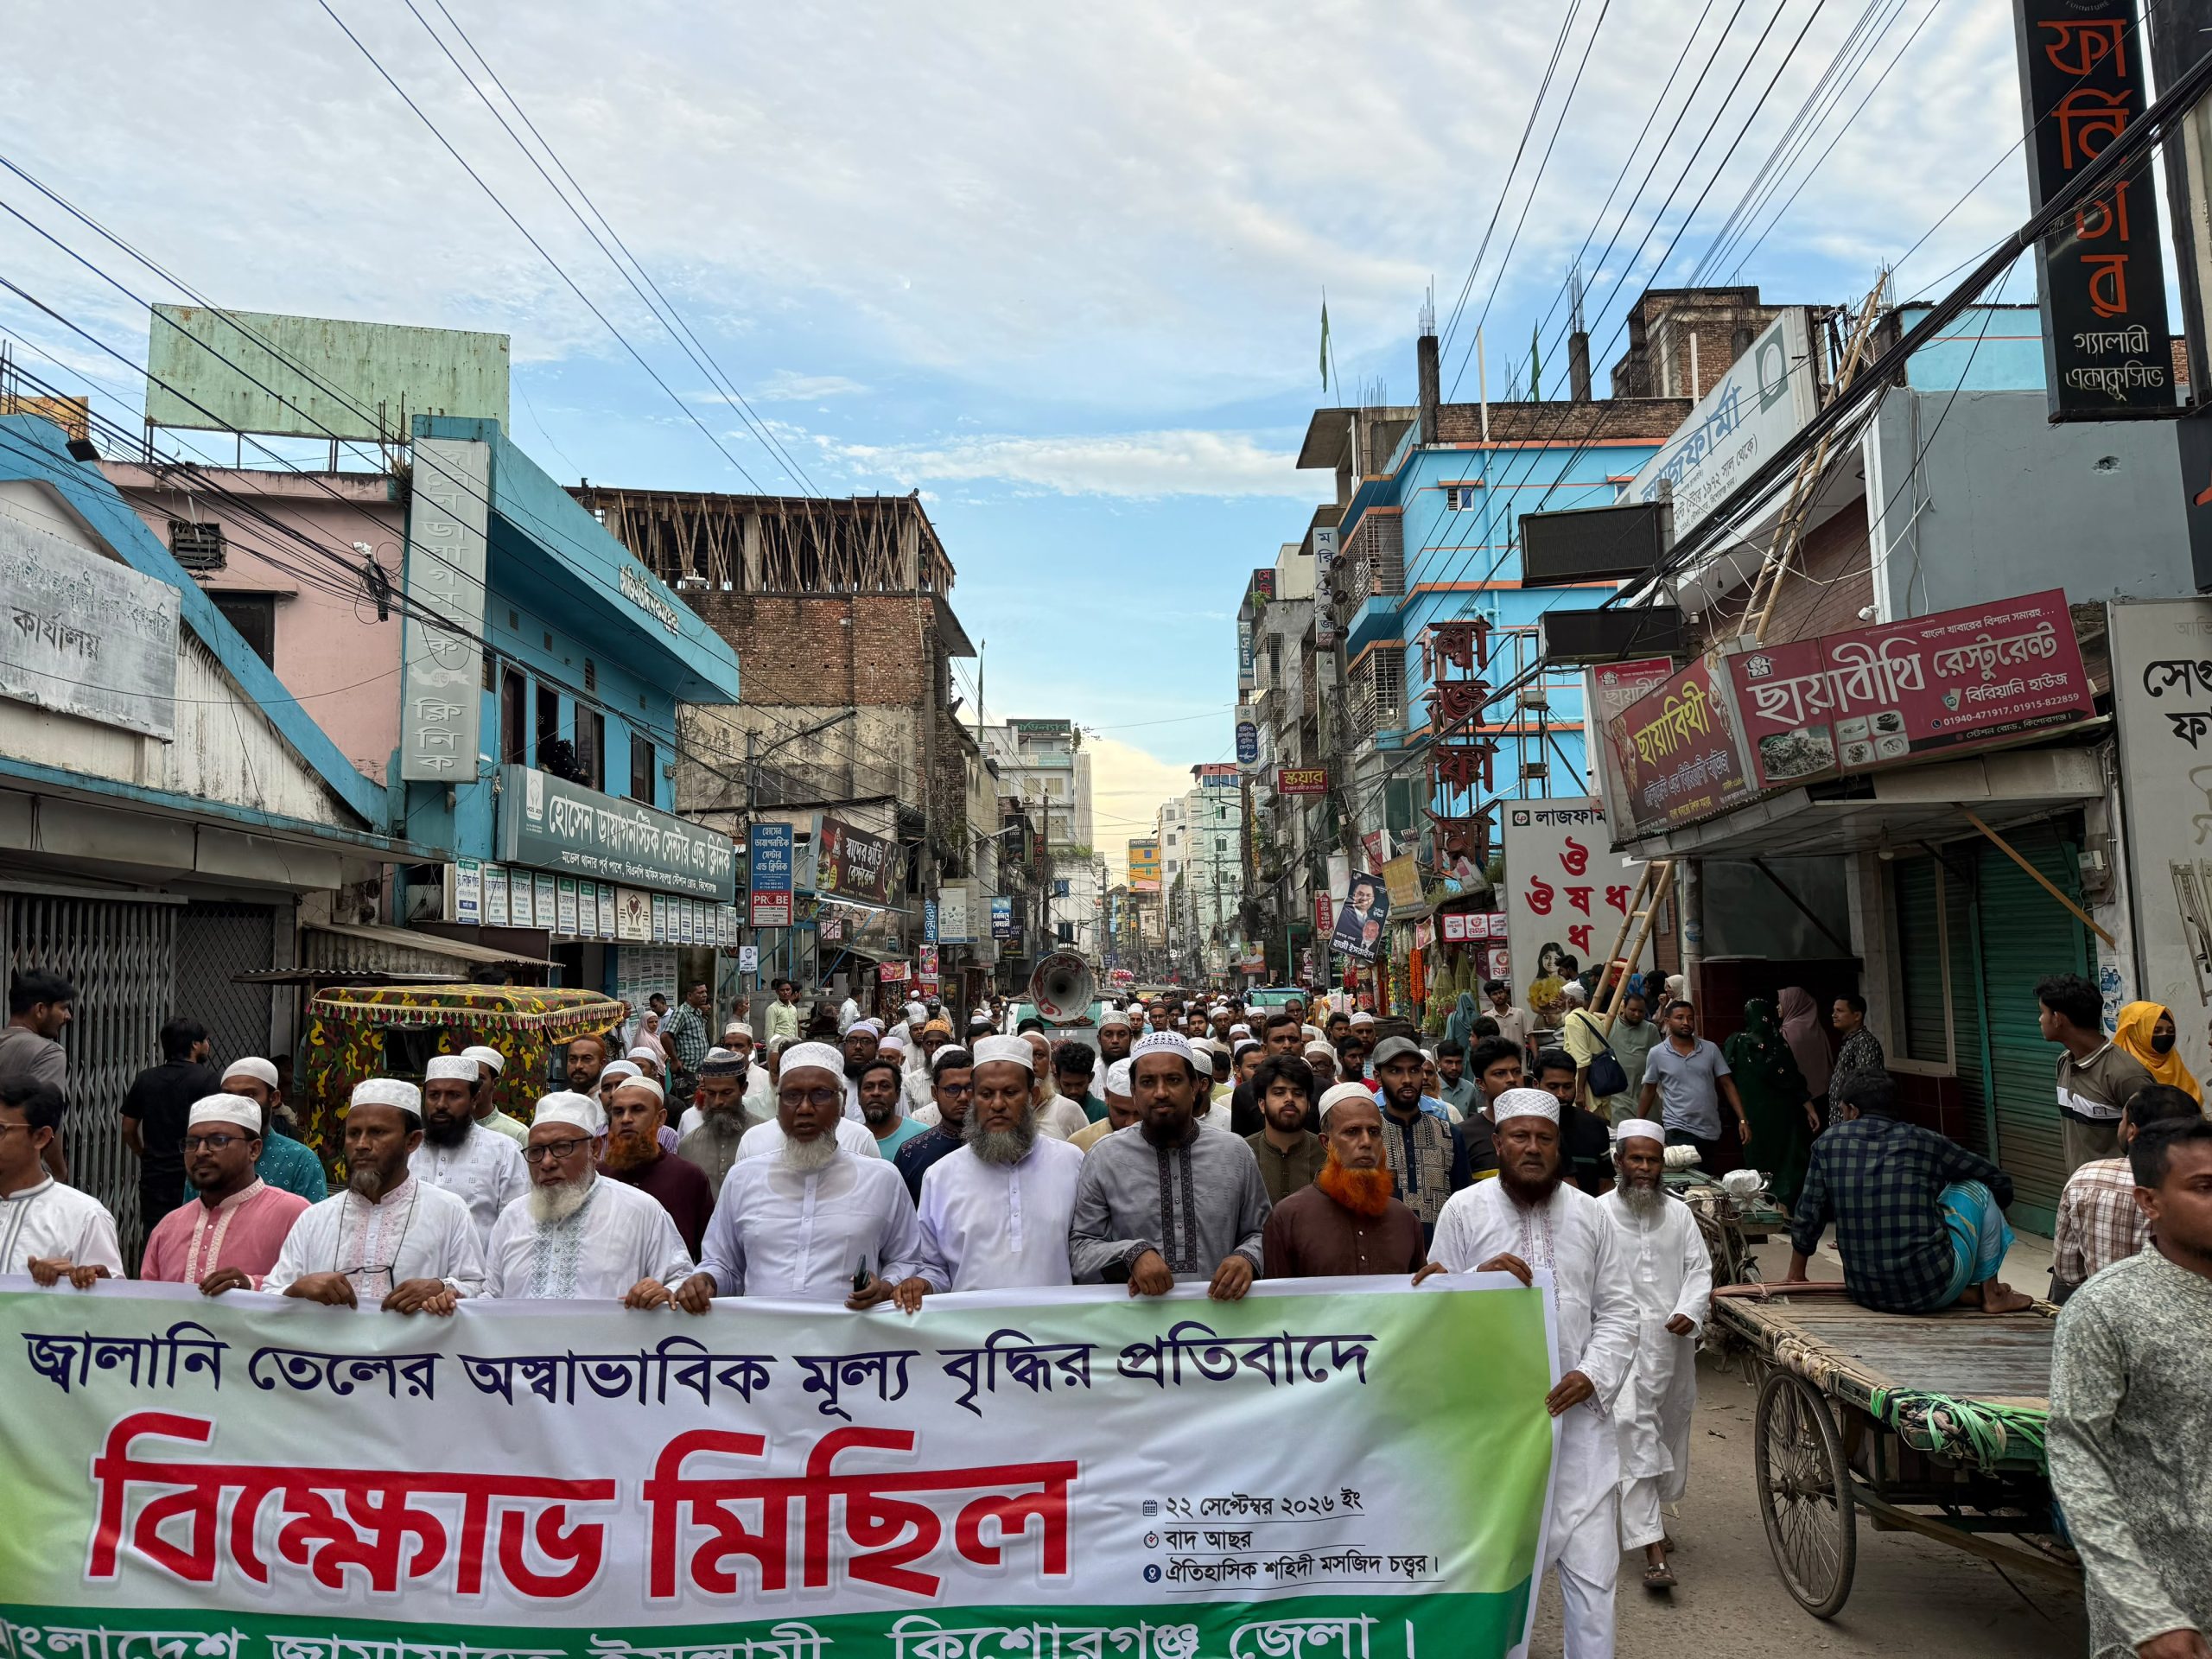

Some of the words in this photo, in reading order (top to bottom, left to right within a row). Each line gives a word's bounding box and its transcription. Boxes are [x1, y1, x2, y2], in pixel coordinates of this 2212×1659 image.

[2073, 325, 2151, 354] গ্যালারী
[1702, 471, 1722, 500] ১৯৭২
[1721, 455, 1735, 477] সাল
[1920, 625, 1945, 639] বাংলা
[1947, 620, 1982, 635] খাবারের
[1984, 613, 2011, 628] বিশাল
[1745, 637, 1926, 726] ছায়াবীথি
[1933, 621, 2057, 681] রেস্টুরেন্ট
[1965, 677, 2025, 704] বিরিয়ানি
[2027, 671, 2068, 692] হাউজ
[1633, 680, 1711, 769] ছায়াবিথী
[1943, 703, 2013, 727] 01940-471917,
[2012, 692, 2080, 714] 01915-822859
[550, 794, 594, 844] হোসেন
[596, 810, 659, 859] ডায়াগনস্টিক
[663, 823, 690, 869] সেন্টার
[691, 840, 707, 871] এন্ড
[708, 834, 731, 877] ক্লিনিক
[762, 827, 782, 836] হোসেন
[762, 849, 782, 860] সেন্টার
[1493, 967, 1510, 976] নগ
[22, 1320, 231, 1395] জ্বালানি
[248, 1344, 444, 1401] তেলের
[458, 1336, 776, 1407] অস্বাভাবিক
[792, 1349, 922, 1420] মূল্য
[938, 1328, 1099, 1417] বৃদ্ধির
[1116, 1320, 1378, 1389] প্রতিবাদে
[87, 1412, 618, 1599] বিক্ষোভ
[642, 1425, 1079, 1599] মিছিল
[1166, 1497, 1193, 1519] ২২
[1200, 1491, 1274, 1516] সেপ্টেম্বর
[1281, 1496, 1334, 1517] ২০২৬
[1340, 1487, 1363, 1511] ইং
[1165, 1530, 1198, 1550] বাদ
[1203, 1530, 1253, 1548] আছর
[1166, 1557, 1257, 1583] ঐতিহাসিক
[1263, 1553, 1315, 1580] শহিদী
[1320, 1548, 1382, 1574] মসজিদ
[1229, 1611, 1381, 1659] জেলা
